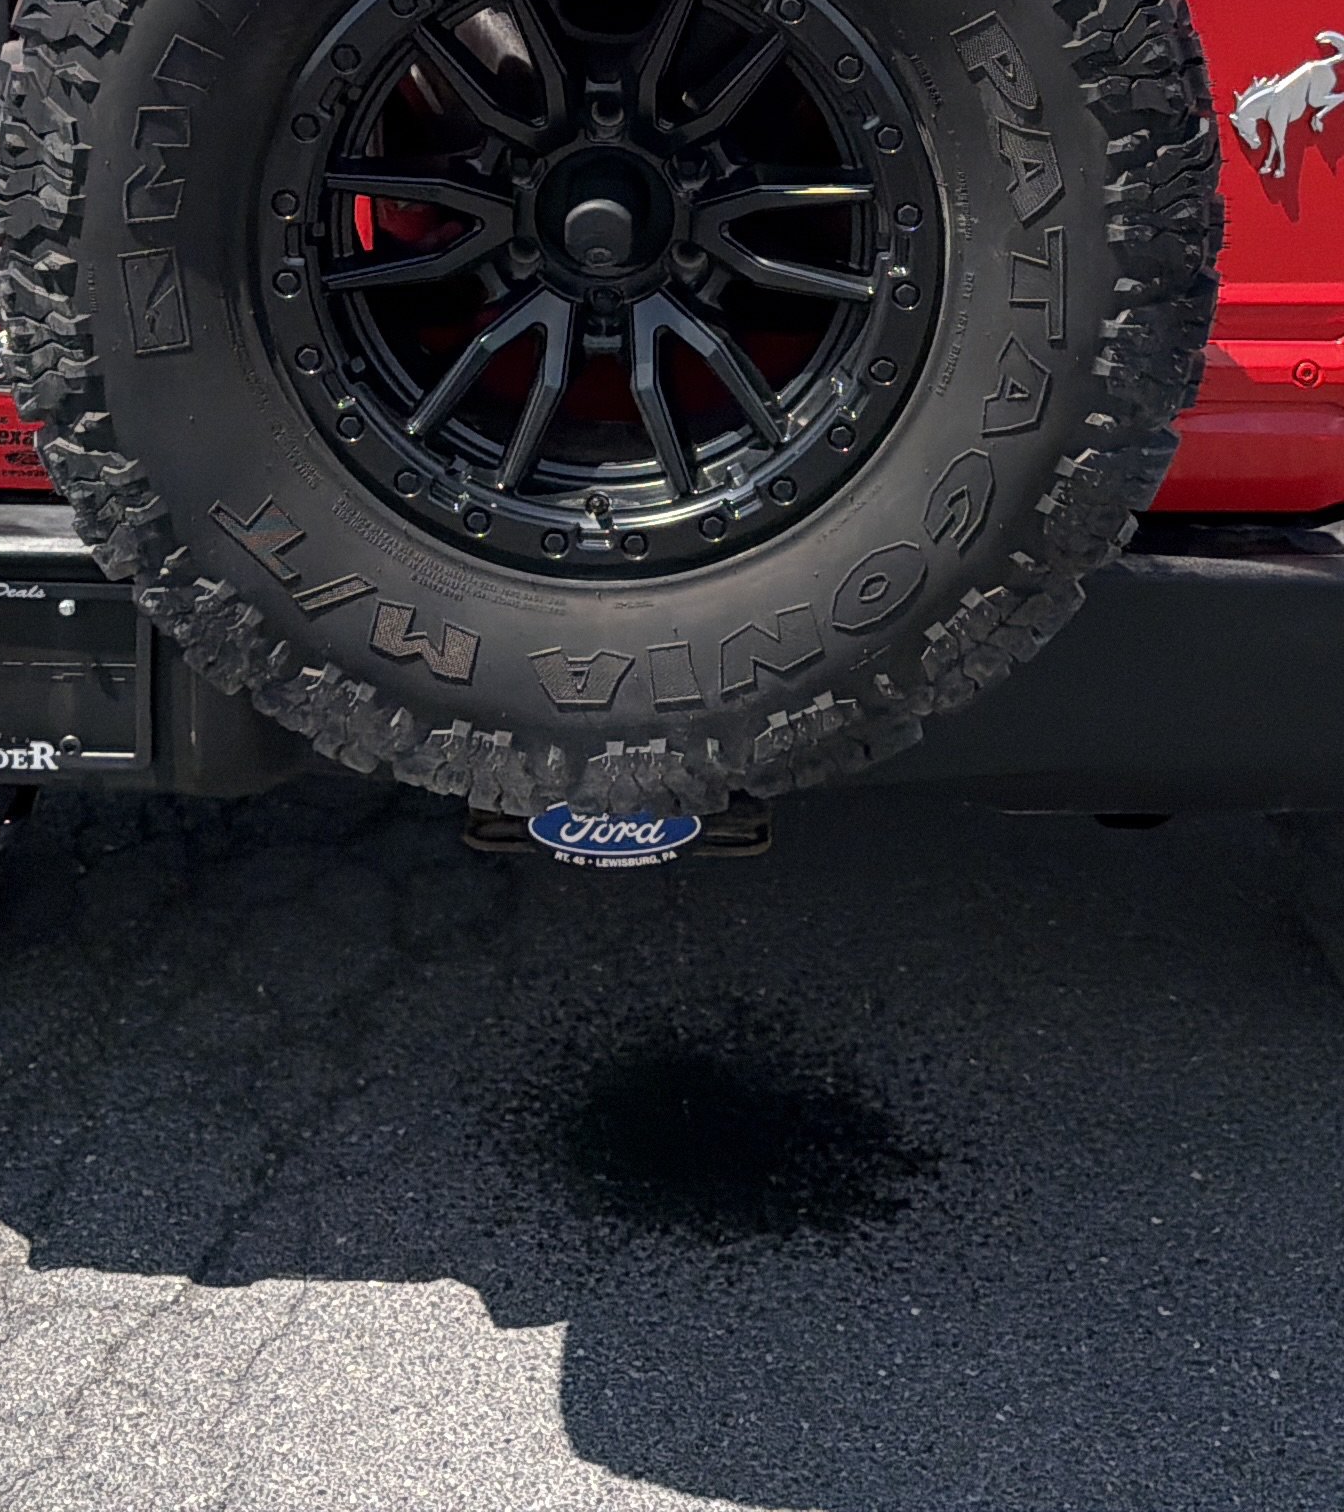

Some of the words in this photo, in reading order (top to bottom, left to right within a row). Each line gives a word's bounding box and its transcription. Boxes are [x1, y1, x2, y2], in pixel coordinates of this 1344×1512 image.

[528, 11, 1065, 706] PATAGONIA
[208, 496, 482, 684] M/T
[554, 851, 570, 863] RT.
[572, 856, 586, 866] 45
[596, 857, 661, 867] LEWISBURG,
[662, 851, 678, 862] PA
[560, 813, 666, 844] Ford
